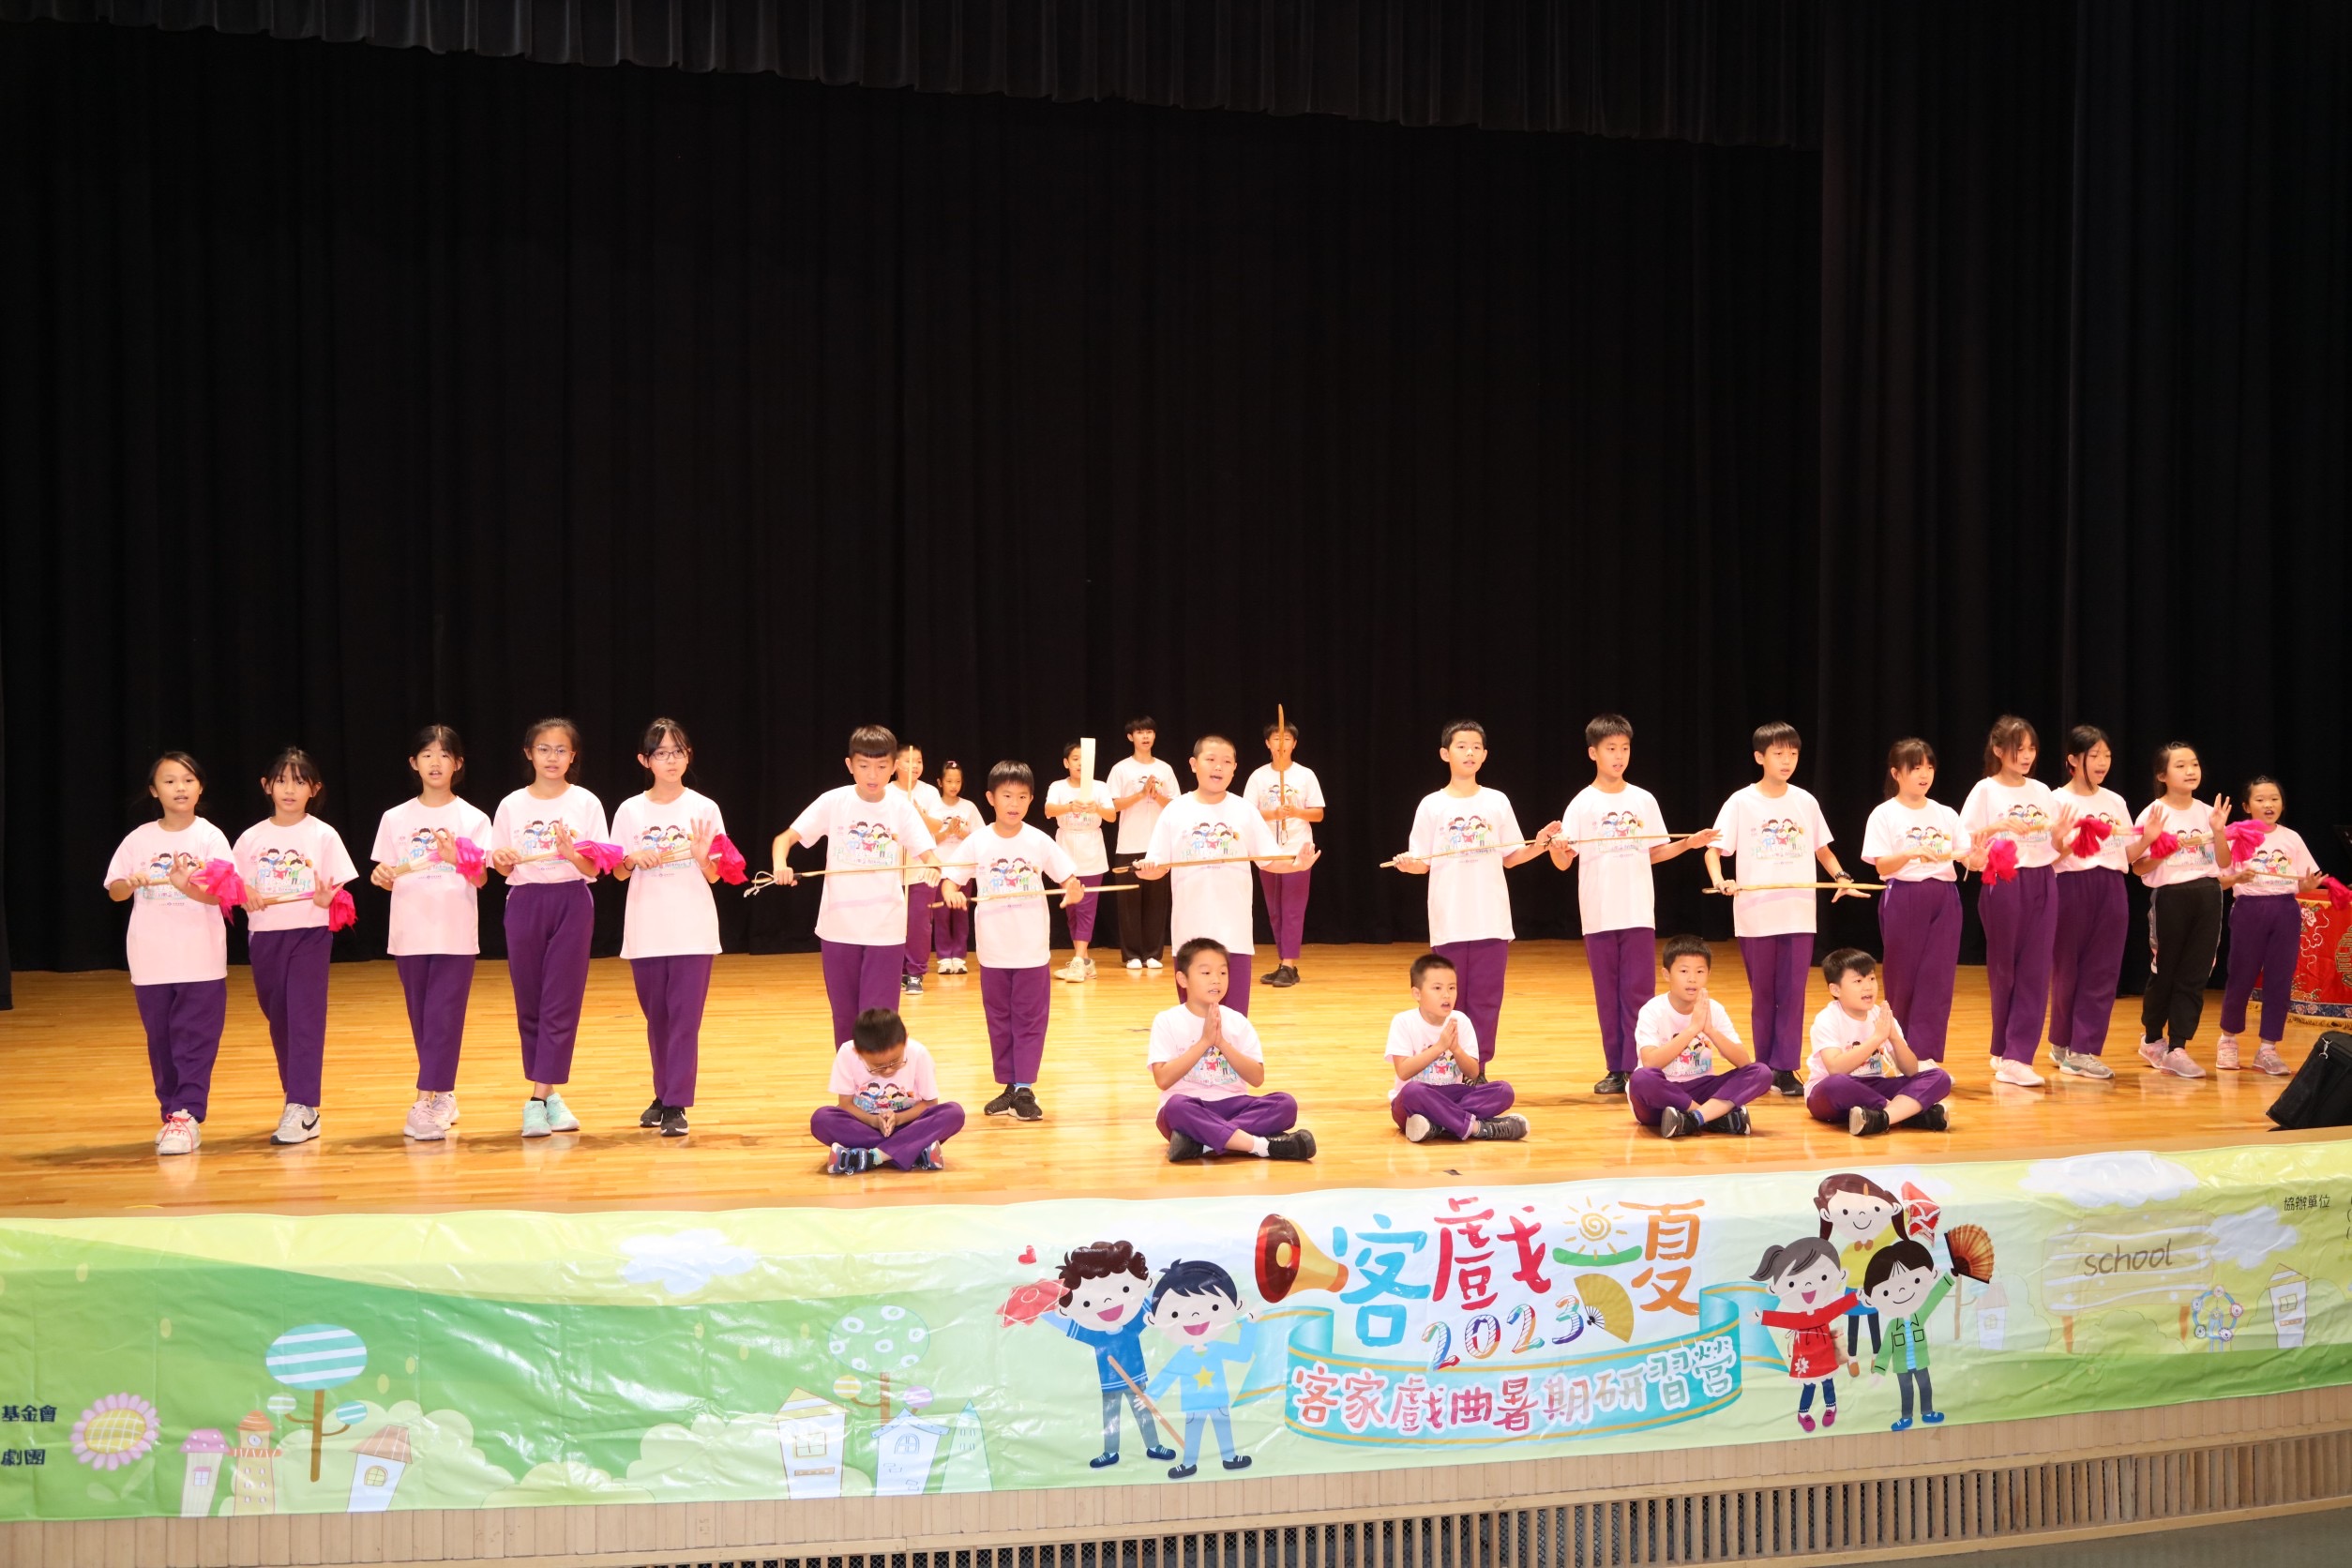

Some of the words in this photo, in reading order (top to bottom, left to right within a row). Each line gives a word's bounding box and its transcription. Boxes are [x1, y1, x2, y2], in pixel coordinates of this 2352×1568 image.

[2284, 1194, 2330, 1212] 協辦單位
[2084, 1238, 2174, 1277] school
[1421, 1294, 1585, 1370] 2023
[1294, 1337, 1736, 1433] 客家戲曲暑期研習營
[2, 1405, 57, 1423] 基金會
[0, 1448, 46, 1466] 劇團
